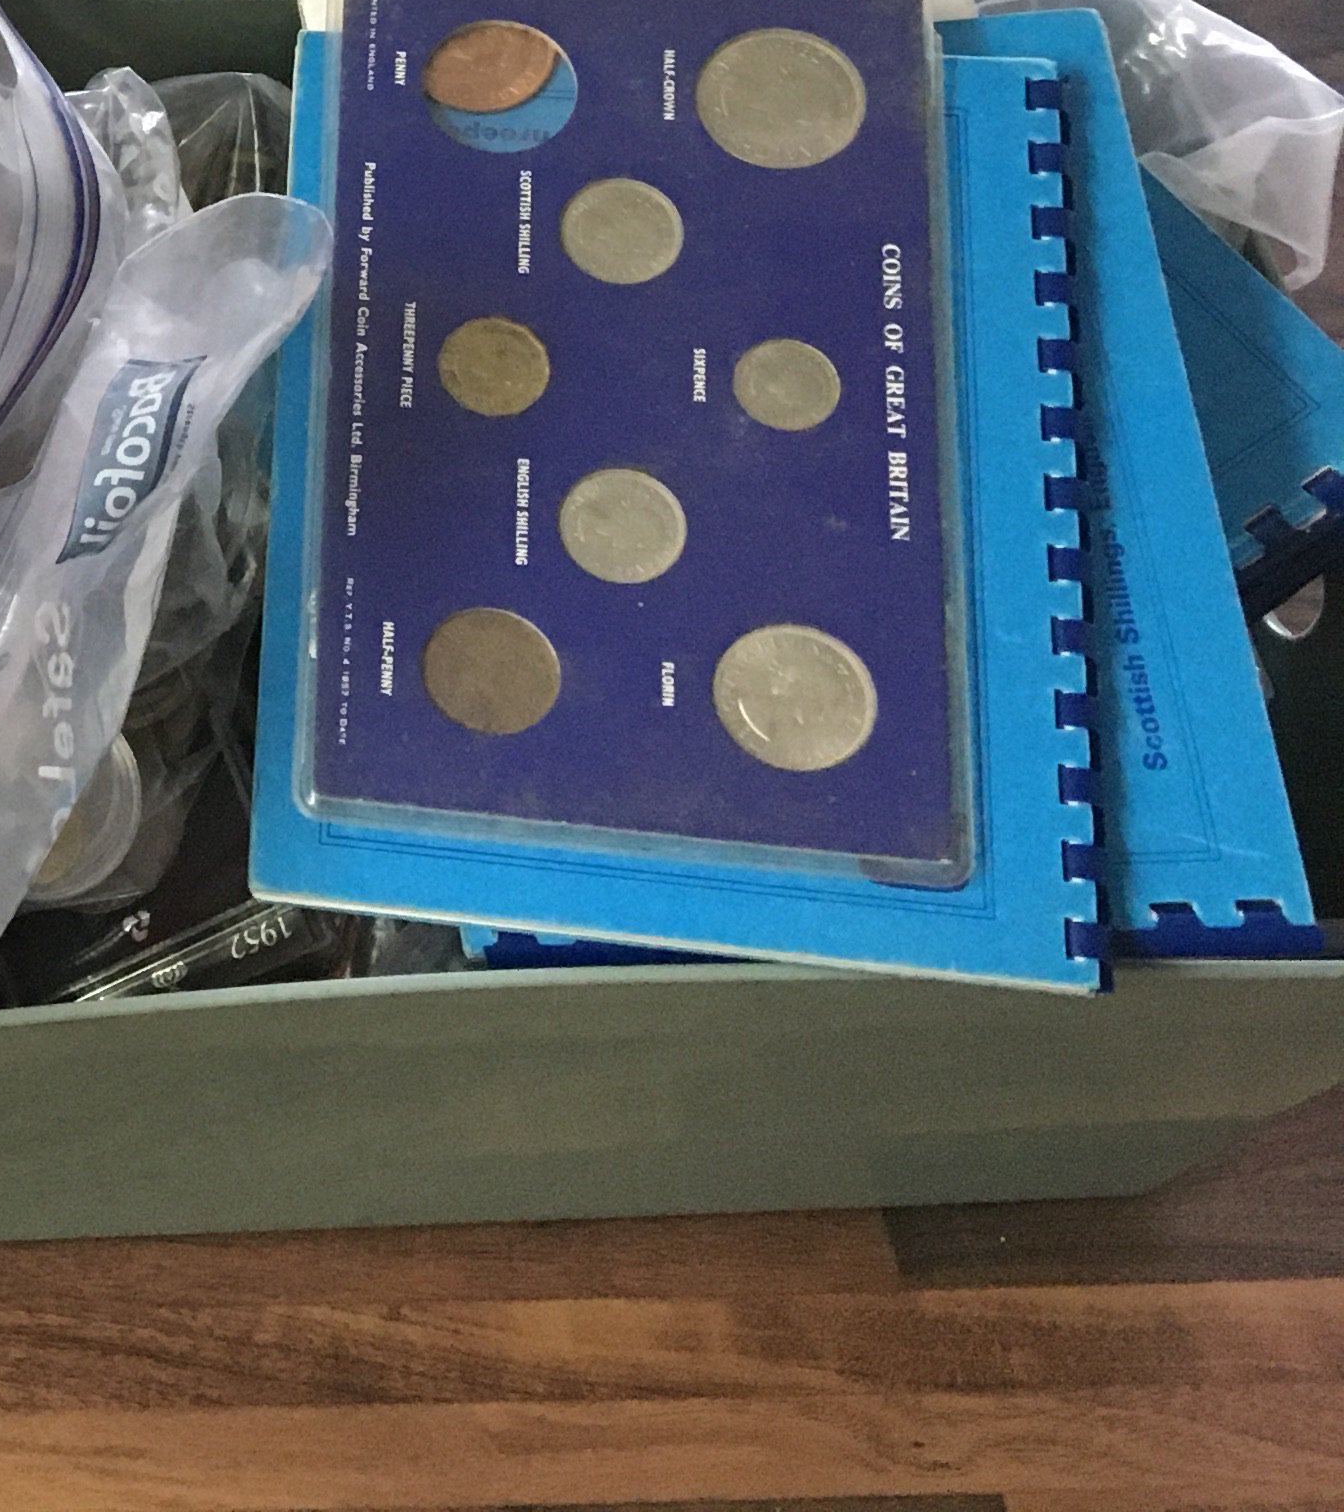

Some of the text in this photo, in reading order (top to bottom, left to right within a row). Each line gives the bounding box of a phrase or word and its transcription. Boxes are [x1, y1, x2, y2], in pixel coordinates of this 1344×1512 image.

[369, 28, 377, 39] IN
[366, 43, 376, 91] ENGLAND
[394, 50, 407, 86] PENNY
[663, 49, 675, 121] HALF-CROWN
[362, 162, 376, 221] Published
[358, 226, 373, 242] by
[518, 170, 532, 275] SCOTTISH SHILLING
[358, 247, 372, 301] Forward
[356, 307, 369, 337] Coin
[352, 342, 368, 417] Accessories
[400, 301, 416, 409] THREEPENNY PIECE
[693, 347, 706, 403] SIXPENCE
[881, 243, 910, 542] COINS OF GREAT BRITAIN
[345, 453, 362, 536] Birmingham
[514, 458, 530, 566] ENGLISH SHILLING
[380, 621, 395, 696] HALF-PENNY
[661, 661, 675, 707] FLORIN
[1123, 653, 1168, 772] Scottish
[231, 914, 294, 960] 1952
